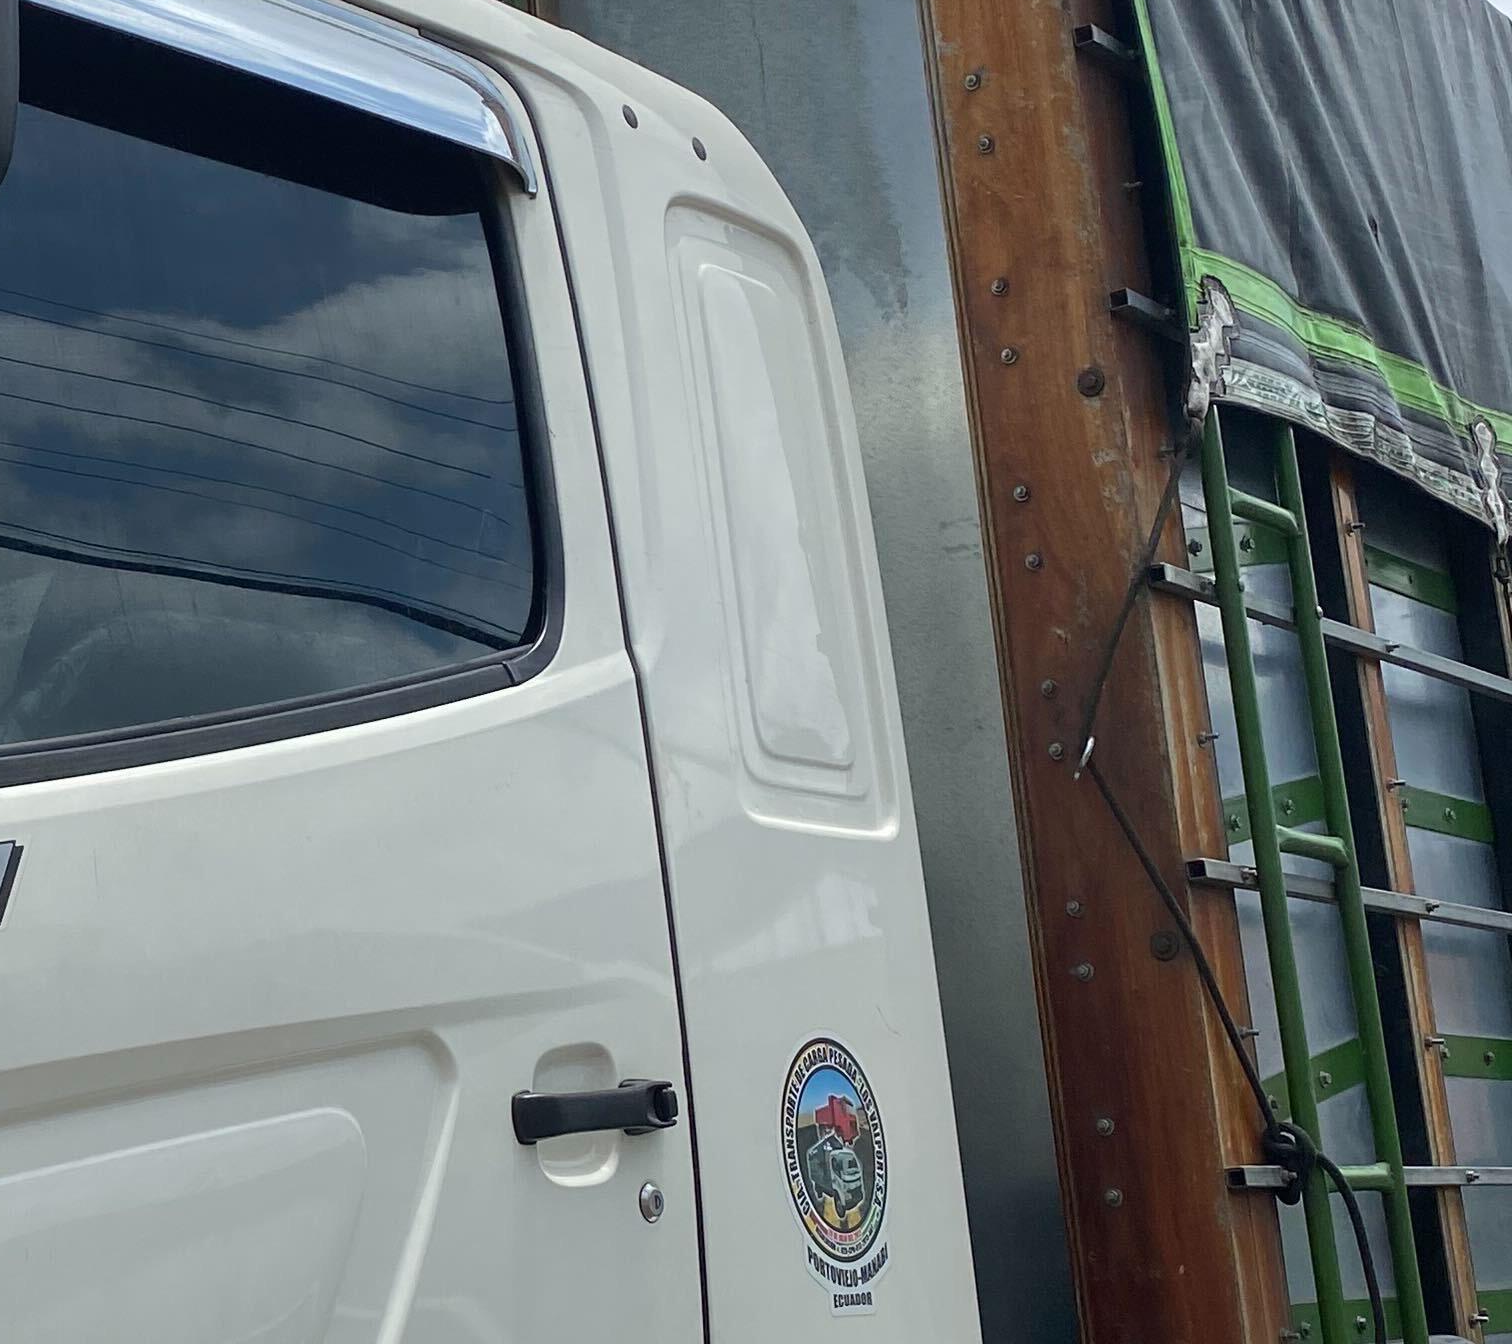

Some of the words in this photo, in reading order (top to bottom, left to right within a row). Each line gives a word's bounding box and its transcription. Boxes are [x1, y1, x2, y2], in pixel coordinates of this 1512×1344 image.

[785, 1079, 800, 1182] TRANSPORTE
[796, 1064, 806, 1085] DE
[802, 1046, 829, 1072] CARGA
[828, 1047, 858, 1083] PESADA
[833, 1291, 873, 1308] ECUADOR
